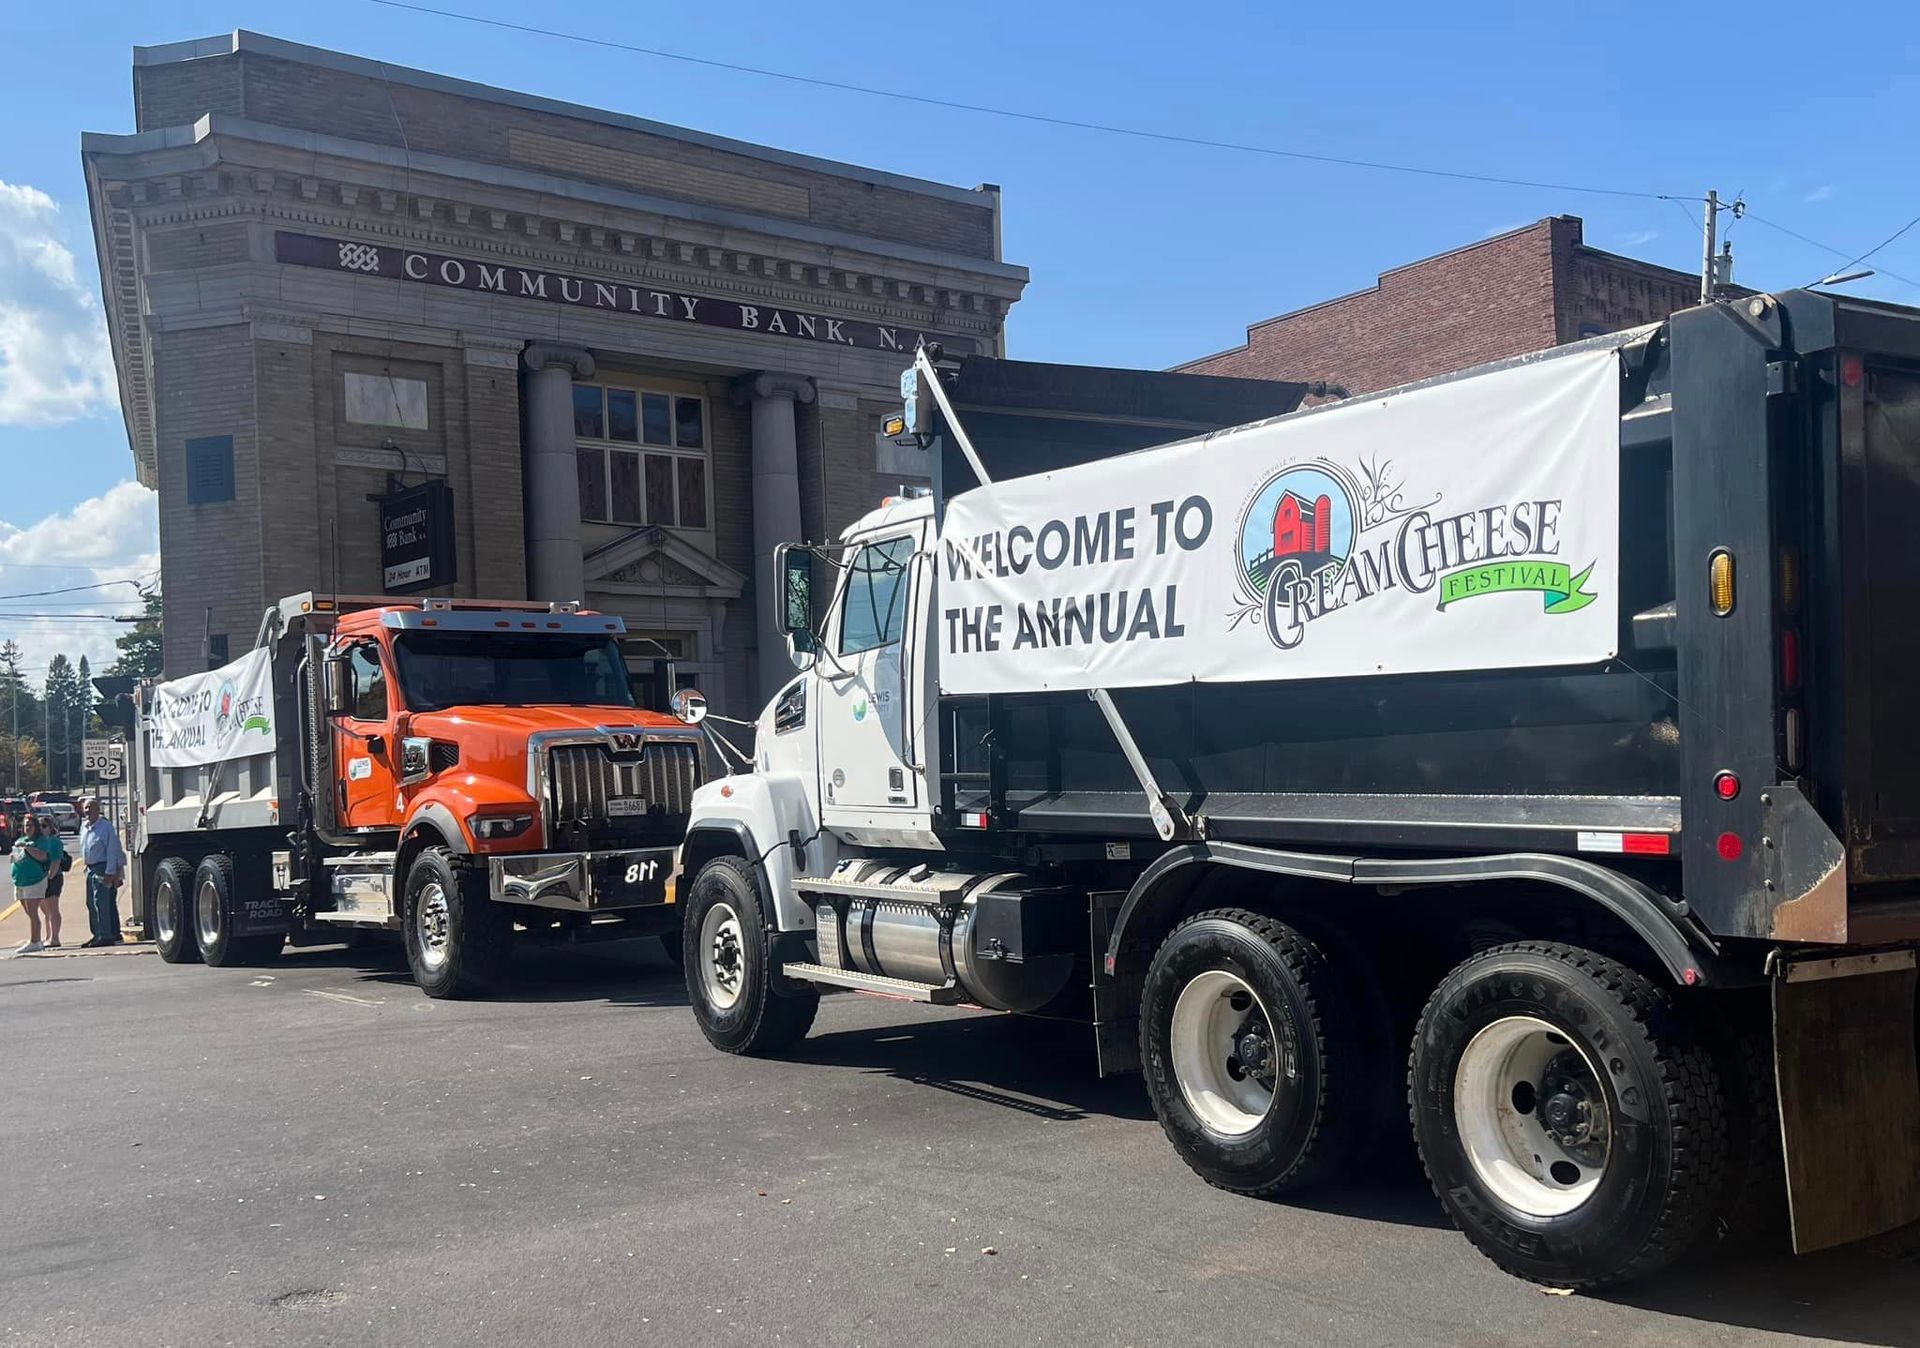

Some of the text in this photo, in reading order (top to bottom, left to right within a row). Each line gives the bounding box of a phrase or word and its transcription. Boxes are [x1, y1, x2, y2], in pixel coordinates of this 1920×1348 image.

[404, 254, 699, 321] COMMUNITY
[384, 507, 428, 532] Community
[399, 525, 418, 546] Bank
[946, 495, 1213, 582] WELCOME TO
[1448, 566, 1564, 597] FESTIVAL
[945, 585, 1185, 655] THE ANNUAL
[868, 690, 890, 704] LEWIS
[86, 756, 108, 768] 30
[250, 909, 282, 919] ROAD
